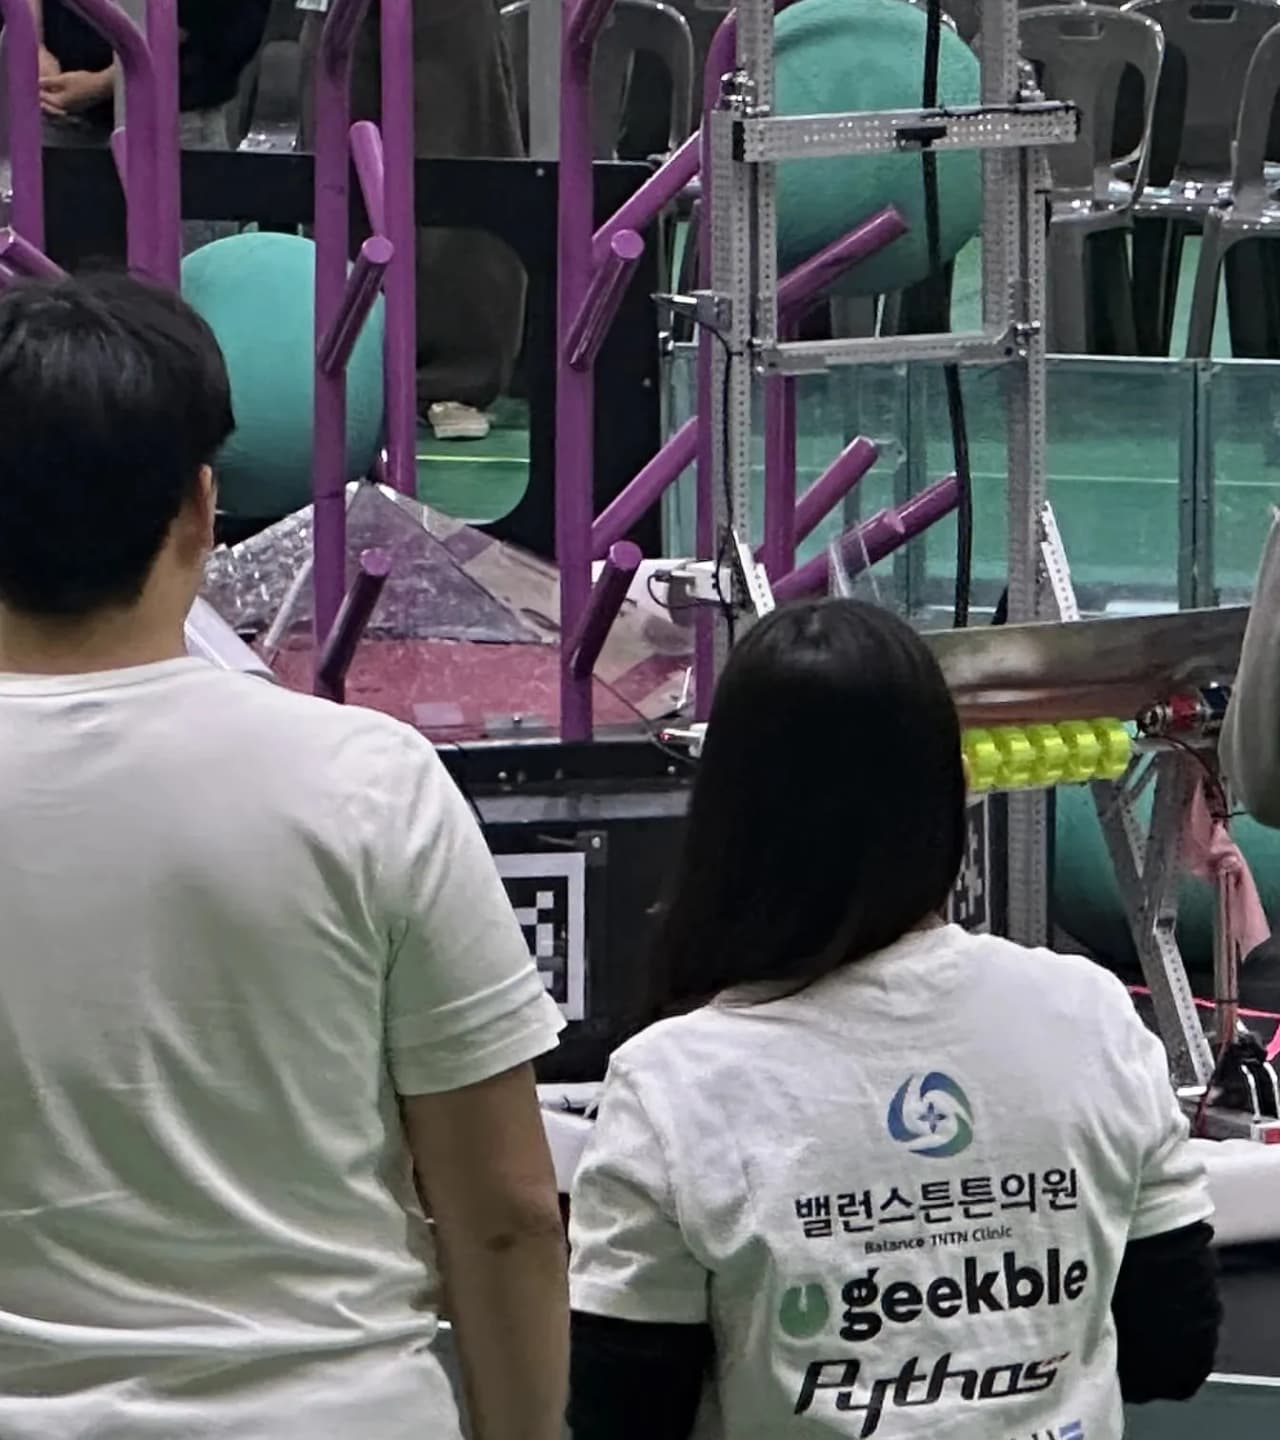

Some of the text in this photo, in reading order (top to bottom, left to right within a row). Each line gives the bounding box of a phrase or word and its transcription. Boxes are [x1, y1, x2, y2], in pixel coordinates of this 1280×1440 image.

[793, 1166, 1078, 1240] 밸런스튼튼의원
[972, 1224, 1013, 1243] Clinic
[838, 1247, 1089, 1343] geekble
